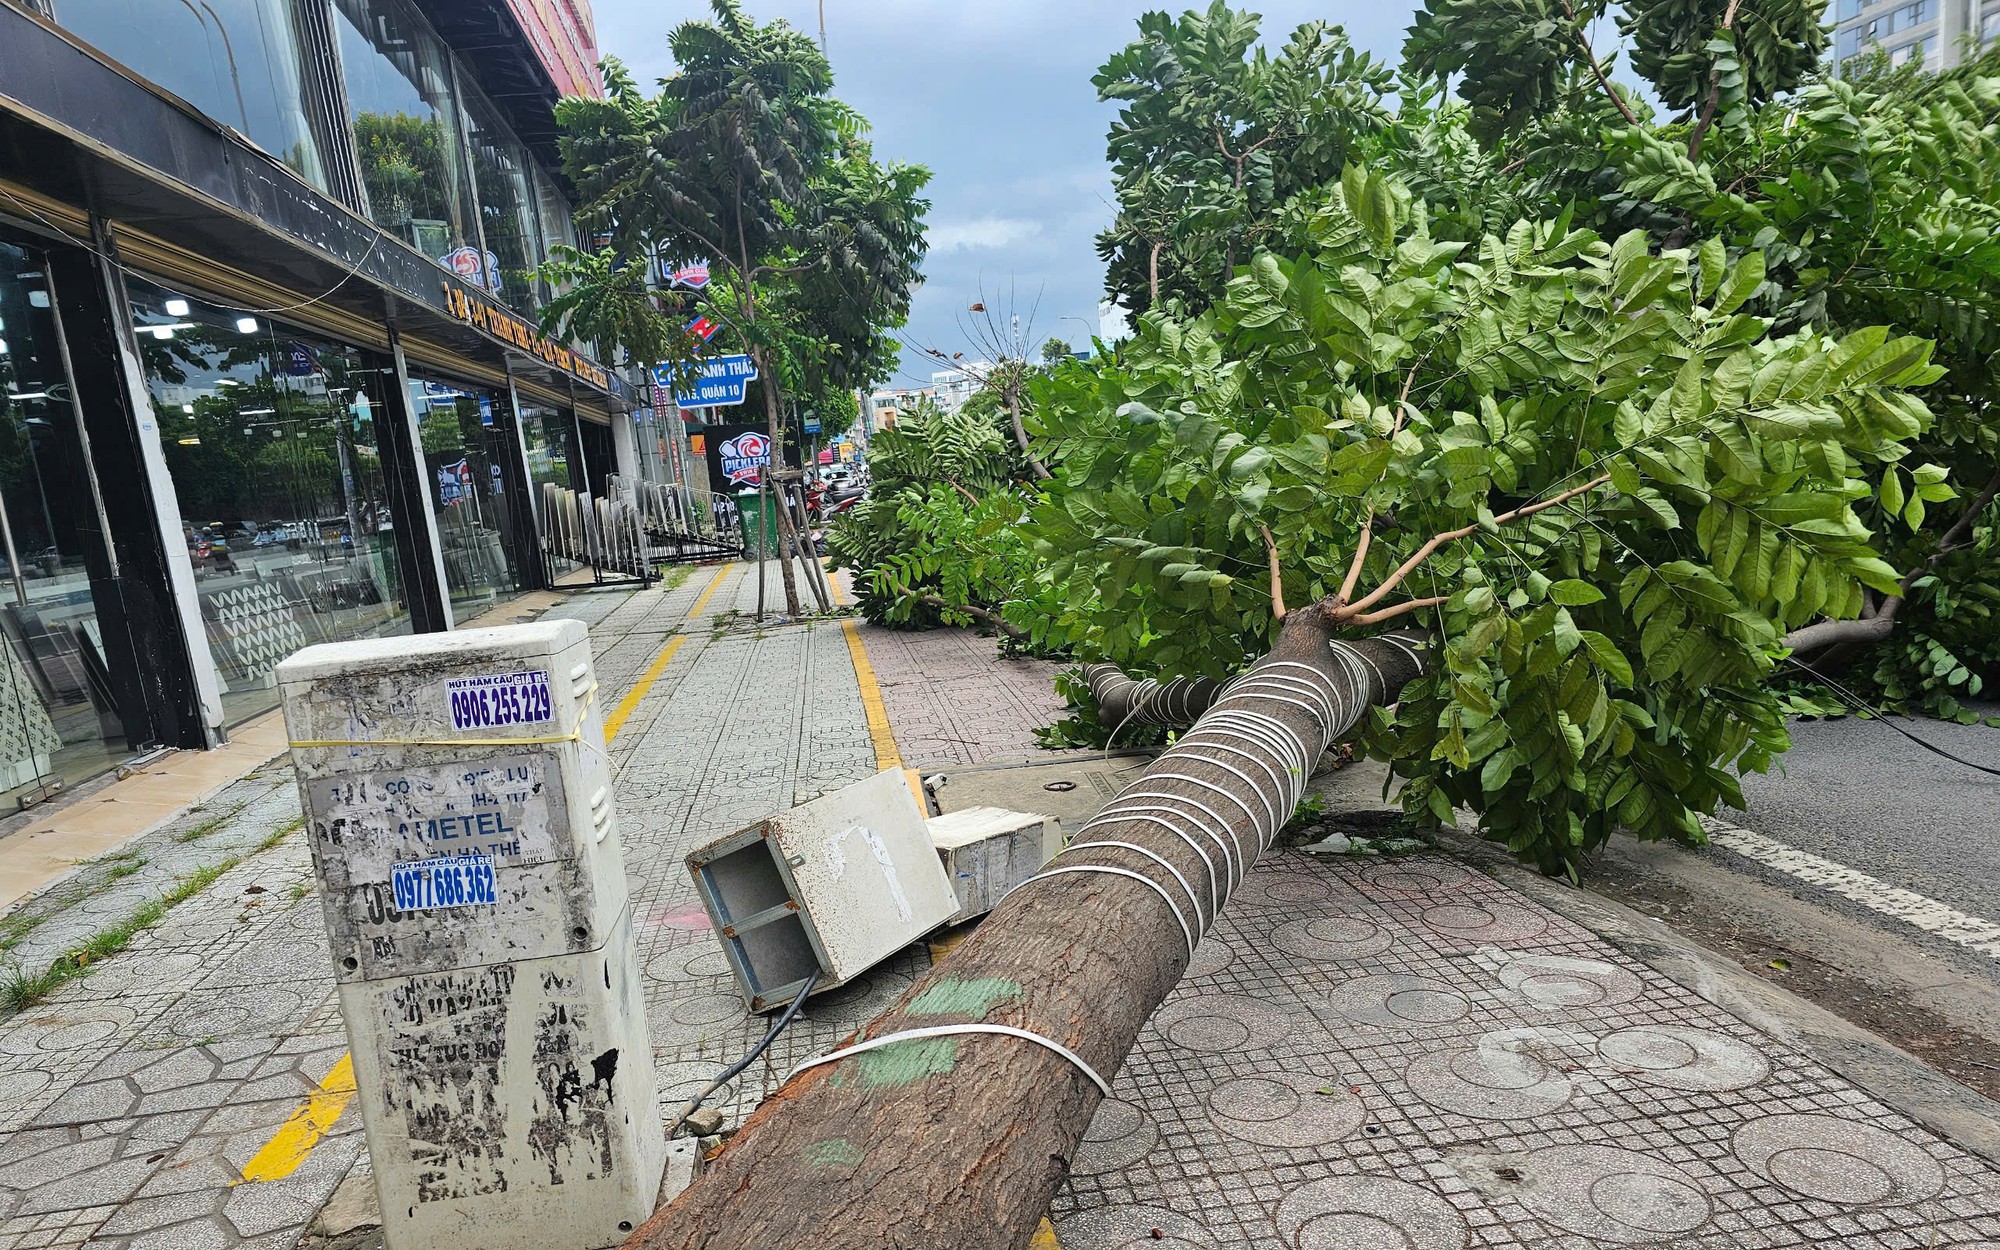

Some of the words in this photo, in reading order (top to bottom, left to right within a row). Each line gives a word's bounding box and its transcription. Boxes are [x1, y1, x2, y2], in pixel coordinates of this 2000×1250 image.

[701, 384, 727, 400] QUẬN
[728, 385, 740, 396] 10
[725, 456, 771, 473] PICKLEBA
[451, 683, 550, 728] 0906.255.229
